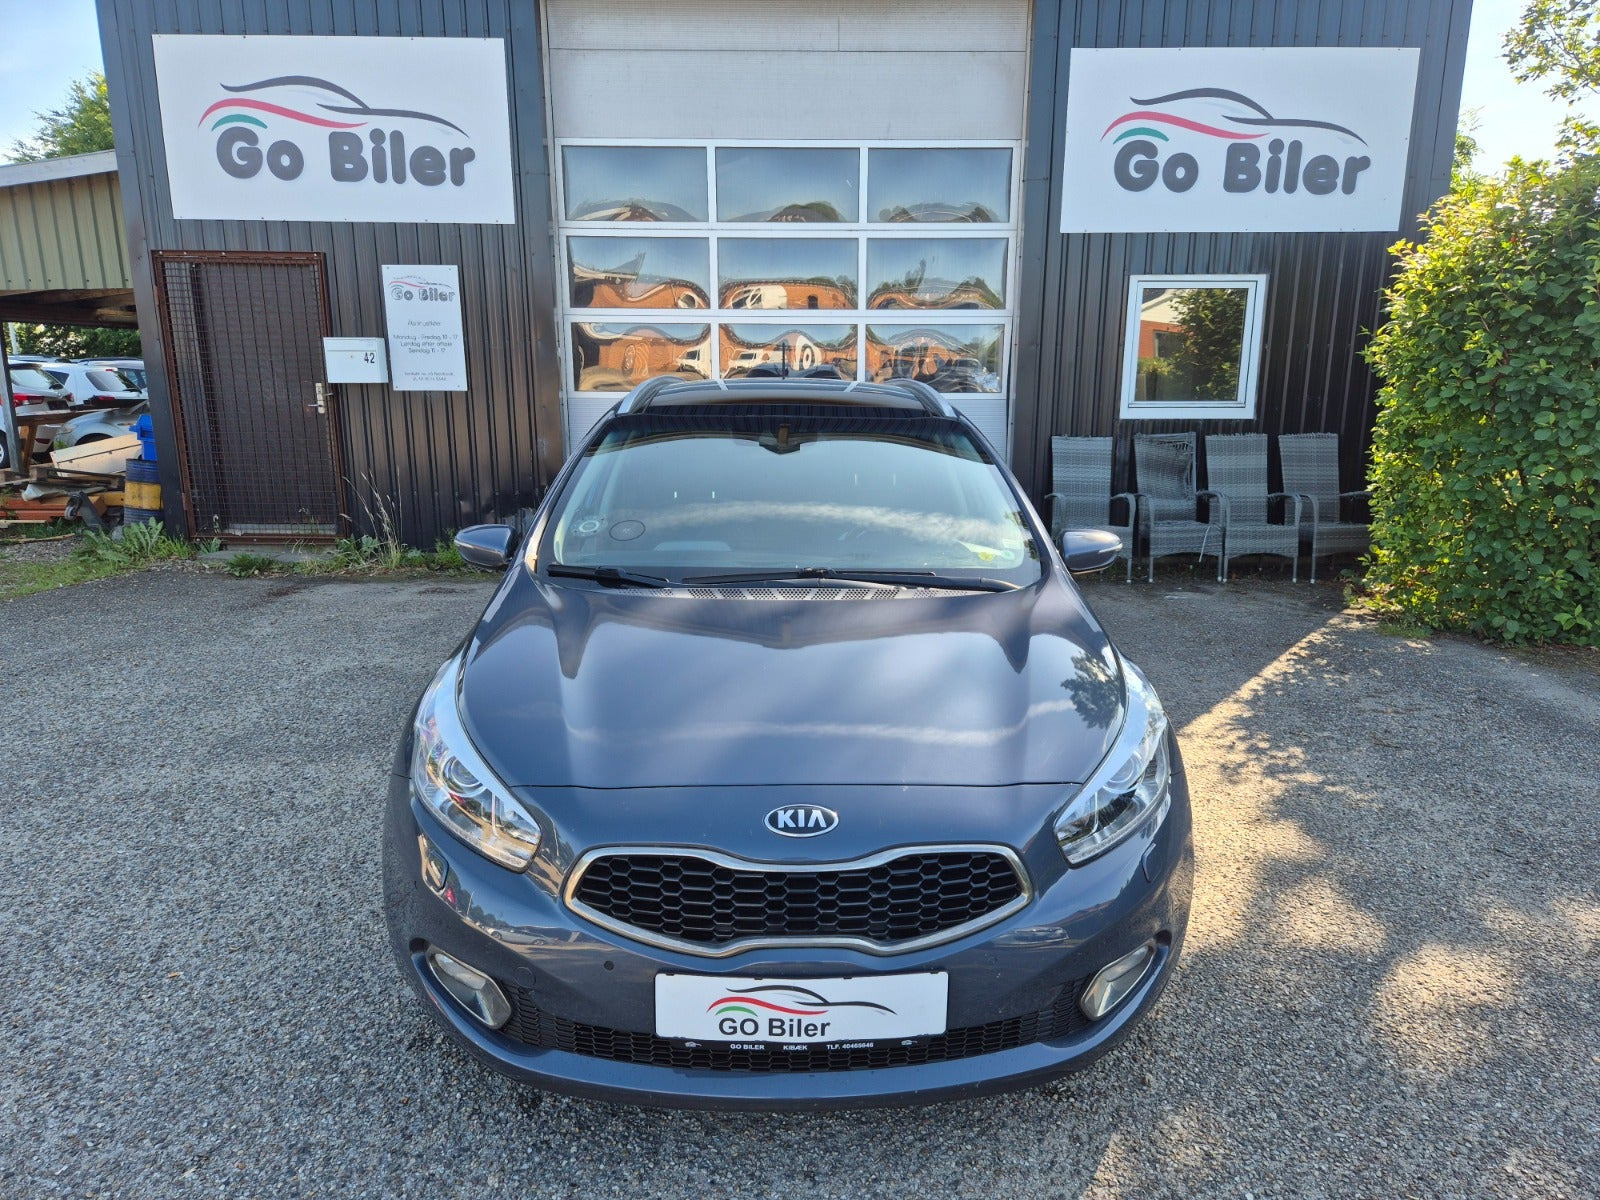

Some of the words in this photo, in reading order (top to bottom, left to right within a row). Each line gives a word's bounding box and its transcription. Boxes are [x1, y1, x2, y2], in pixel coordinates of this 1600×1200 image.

[216, 126, 304, 181] Go
[328, 128, 476, 187] Biler
[1114, 139, 1199, 193] Go
[1223, 138, 1371, 195] Biler
[391, 287, 413, 301] Go
[418, 287, 456, 302] Biler
[364, 352, 375, 364] 42
[777, 809, 827, 828] KIA
[718, 1017, 759, 1036] GO
[768, 1018, 831, 1037] Biler
